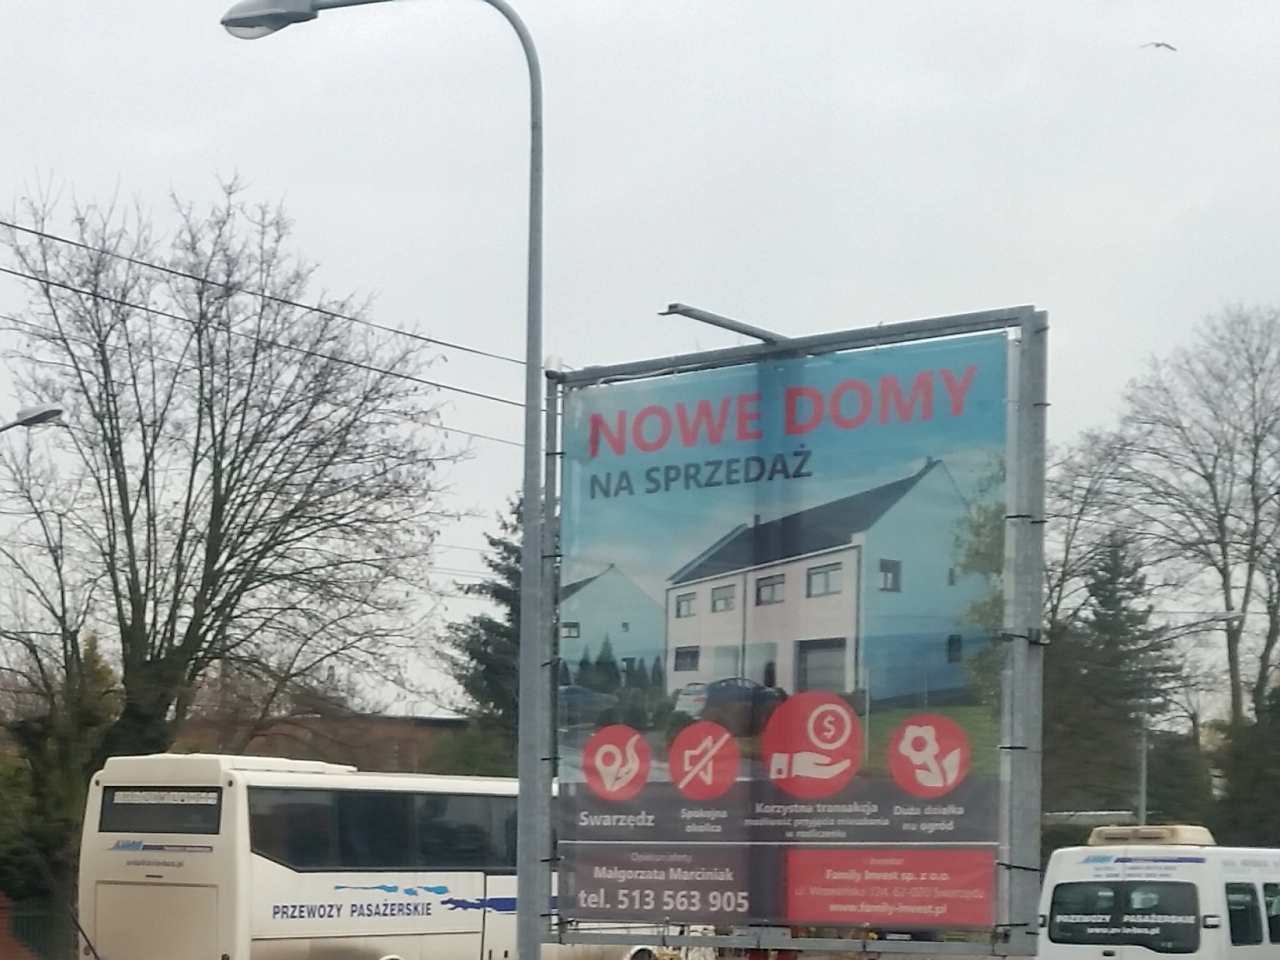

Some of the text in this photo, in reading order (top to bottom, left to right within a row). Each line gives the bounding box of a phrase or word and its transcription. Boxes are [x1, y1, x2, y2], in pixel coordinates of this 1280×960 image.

[589, 364, 978, 459] NOWE DOMY
[589, 443, 814, 500] NA SPRZEDAŻ
[755, 802, 879, 816] Korzystna transakcja
[578, 810, 656, 830] Swarzędz
[920, 820, 955, 833] ogród
[593, 866, 734, 882] Małgorzata Marciniak
[825, 869, 862, 882] Family
[864, 869, 899, 880] Invest
[272, 898, 433, 920] PRZEWOZY PASAŻERSKIE
[578, 888, 750, 912] tel. 513 563 905
